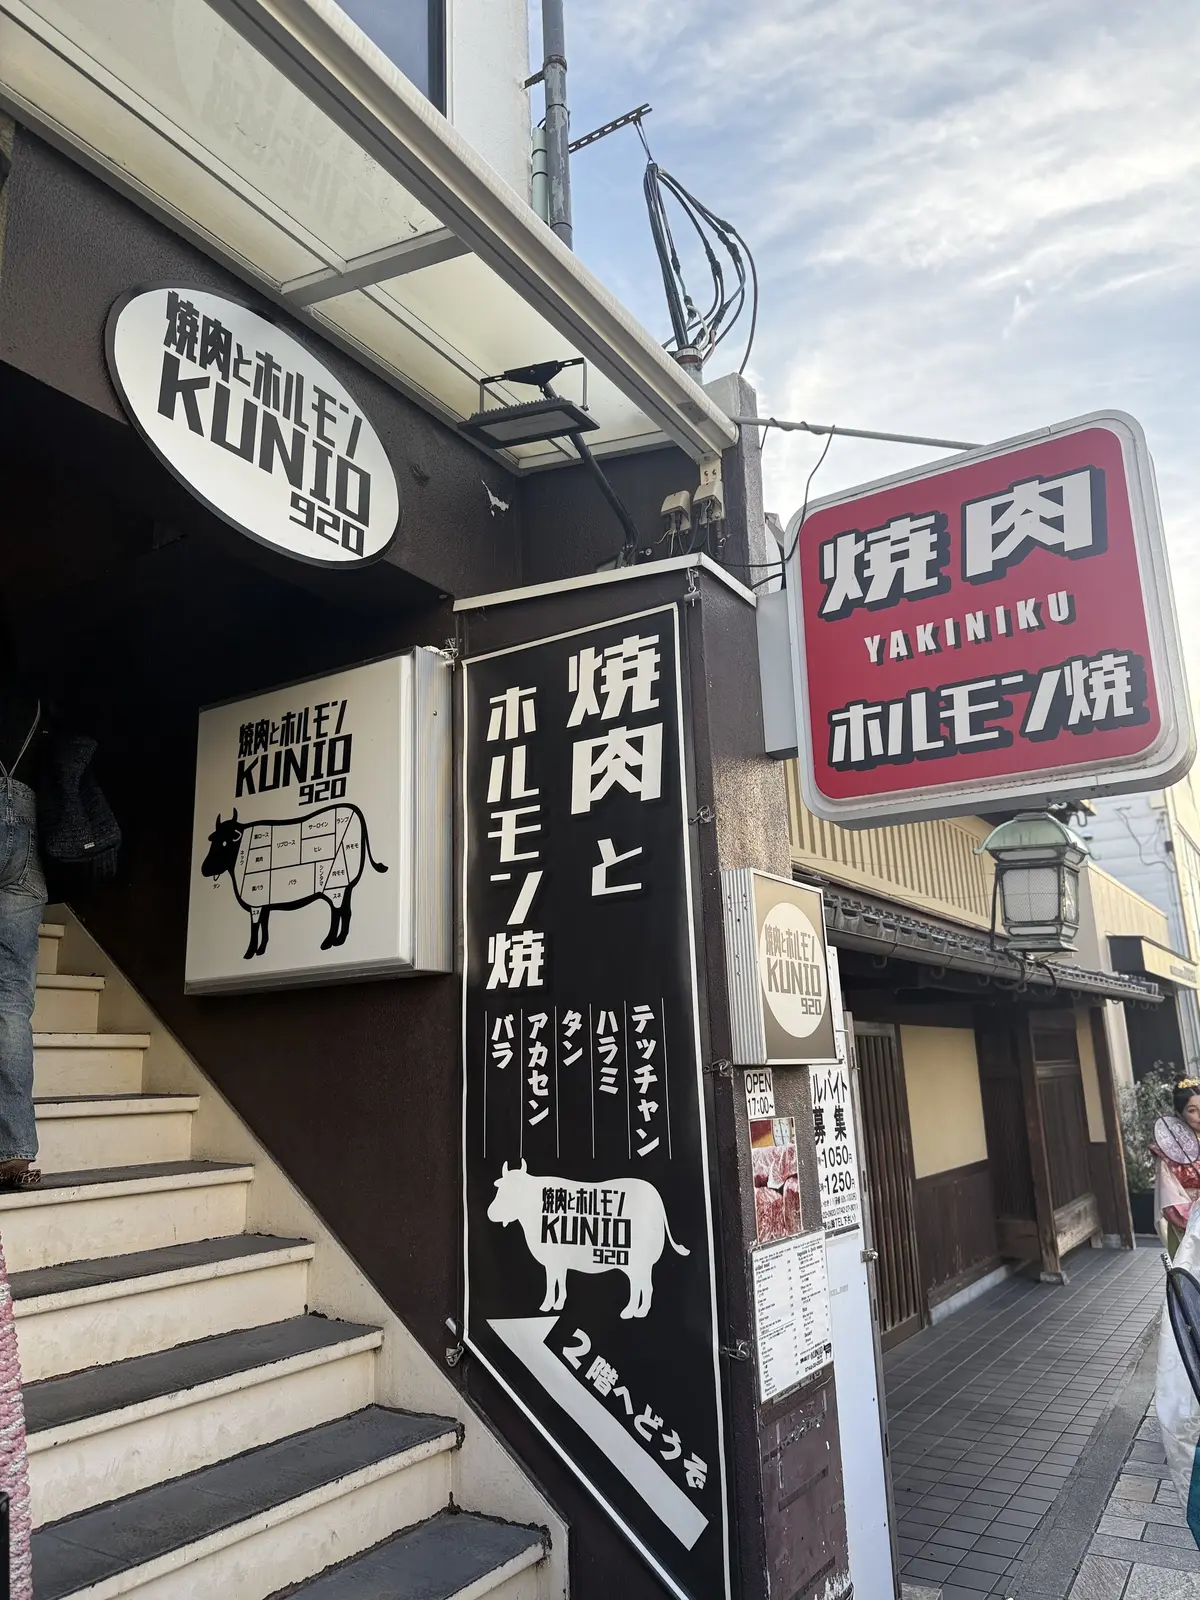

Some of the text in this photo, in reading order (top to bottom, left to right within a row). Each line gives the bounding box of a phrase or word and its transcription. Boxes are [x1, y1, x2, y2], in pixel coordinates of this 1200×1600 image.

[163, 290, 363, 460] 焼肉とホルモン
[157, 350, 372, 528] KUNIO
[289, 490, 365, 557] 920
[822, 470, 1093, 614] 焼肉
[863, 590, 1070, 663] YAKINIKU
[238, 699, 348, 759] 焼肉とホルモン
[831, 654, 1134, 763] ホルモン焼
[235, 733, 352, 798] KUNIO
[298, 776, 347, 806] 920
[566, 634, 663, 896] 焼肉と
[486, 686, 546, 990] ホルモン焼
[764, 923, 815, 962] 焼肉とホルモン
[766, 957, 822, 997] KUNIO
[800, 997, 822, 1016] 920
[491, 1013, 515, 1069] バラ
[527, 1012, 549, 1126] アカセン
[561, 1009, 583, 1066] タン
[596, 1010, 619, 1095] ハラミ
[631, 1004, 660, 1157] テッチャン
[745, 1073, 772, 1095] OPEN
[812, 1069, 848, 1105] ルバイト
[540, 1214, 632, 1249] KUNIO
[541, 1187, 625, 1217] 焼肉とホルモン
[592, 1248, 629, 1266] 920
[561, 1328, 709, 1490] 2階へどうぞ
